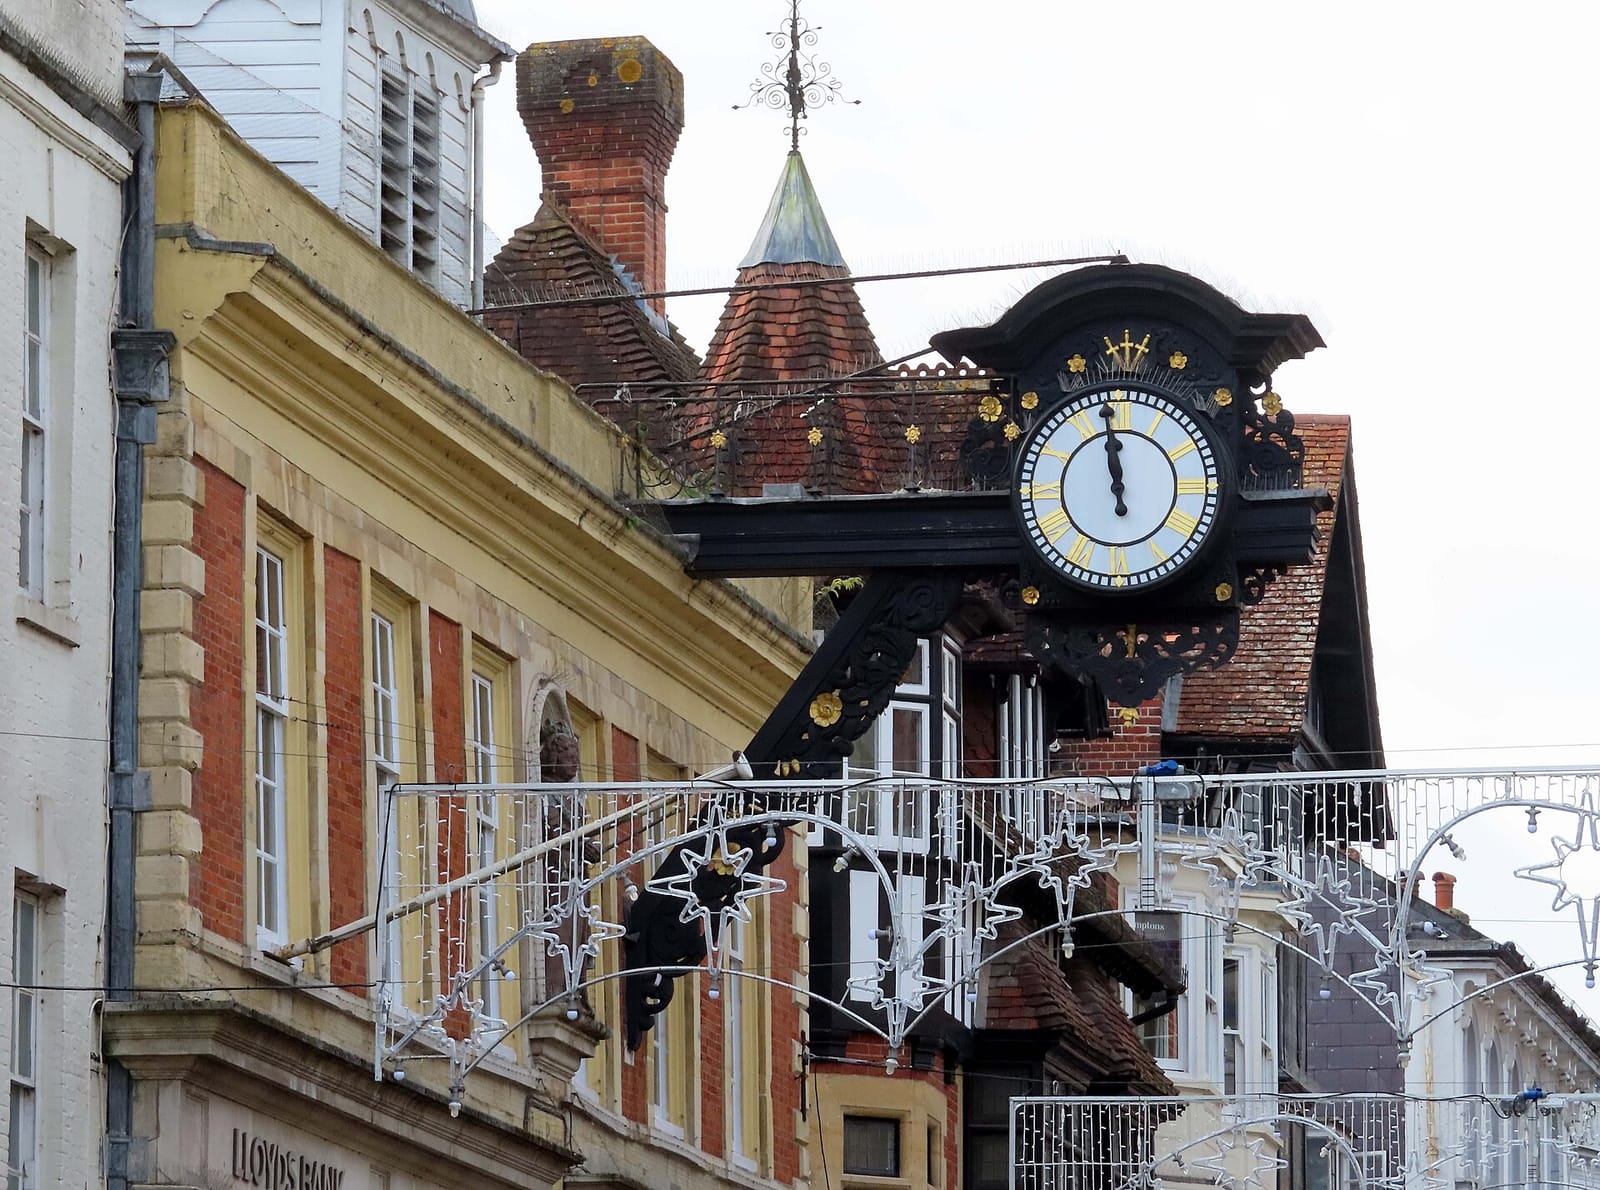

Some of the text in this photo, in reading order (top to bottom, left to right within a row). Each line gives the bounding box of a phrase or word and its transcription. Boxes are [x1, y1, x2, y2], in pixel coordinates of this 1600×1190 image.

[1067, 409, 1099, 442] XI
[1147, 409, 1166, 437] I
[1039, 443, 1072, 466] X
[1168, 438, 1198, 464] II
[1032, 480, 1062, 501] IX
[1177, 477, 1207, 496] III
[1035, 506, 1073, 547] VIII
[1165, 506, 1199, 539] IIII
[1064, 533, 1096, 571] VII
[1108, 546, 1131, 576] VI
[1149, 538, 1169, 564] V
[232, 1127, 296, 1190] LLOYDS
